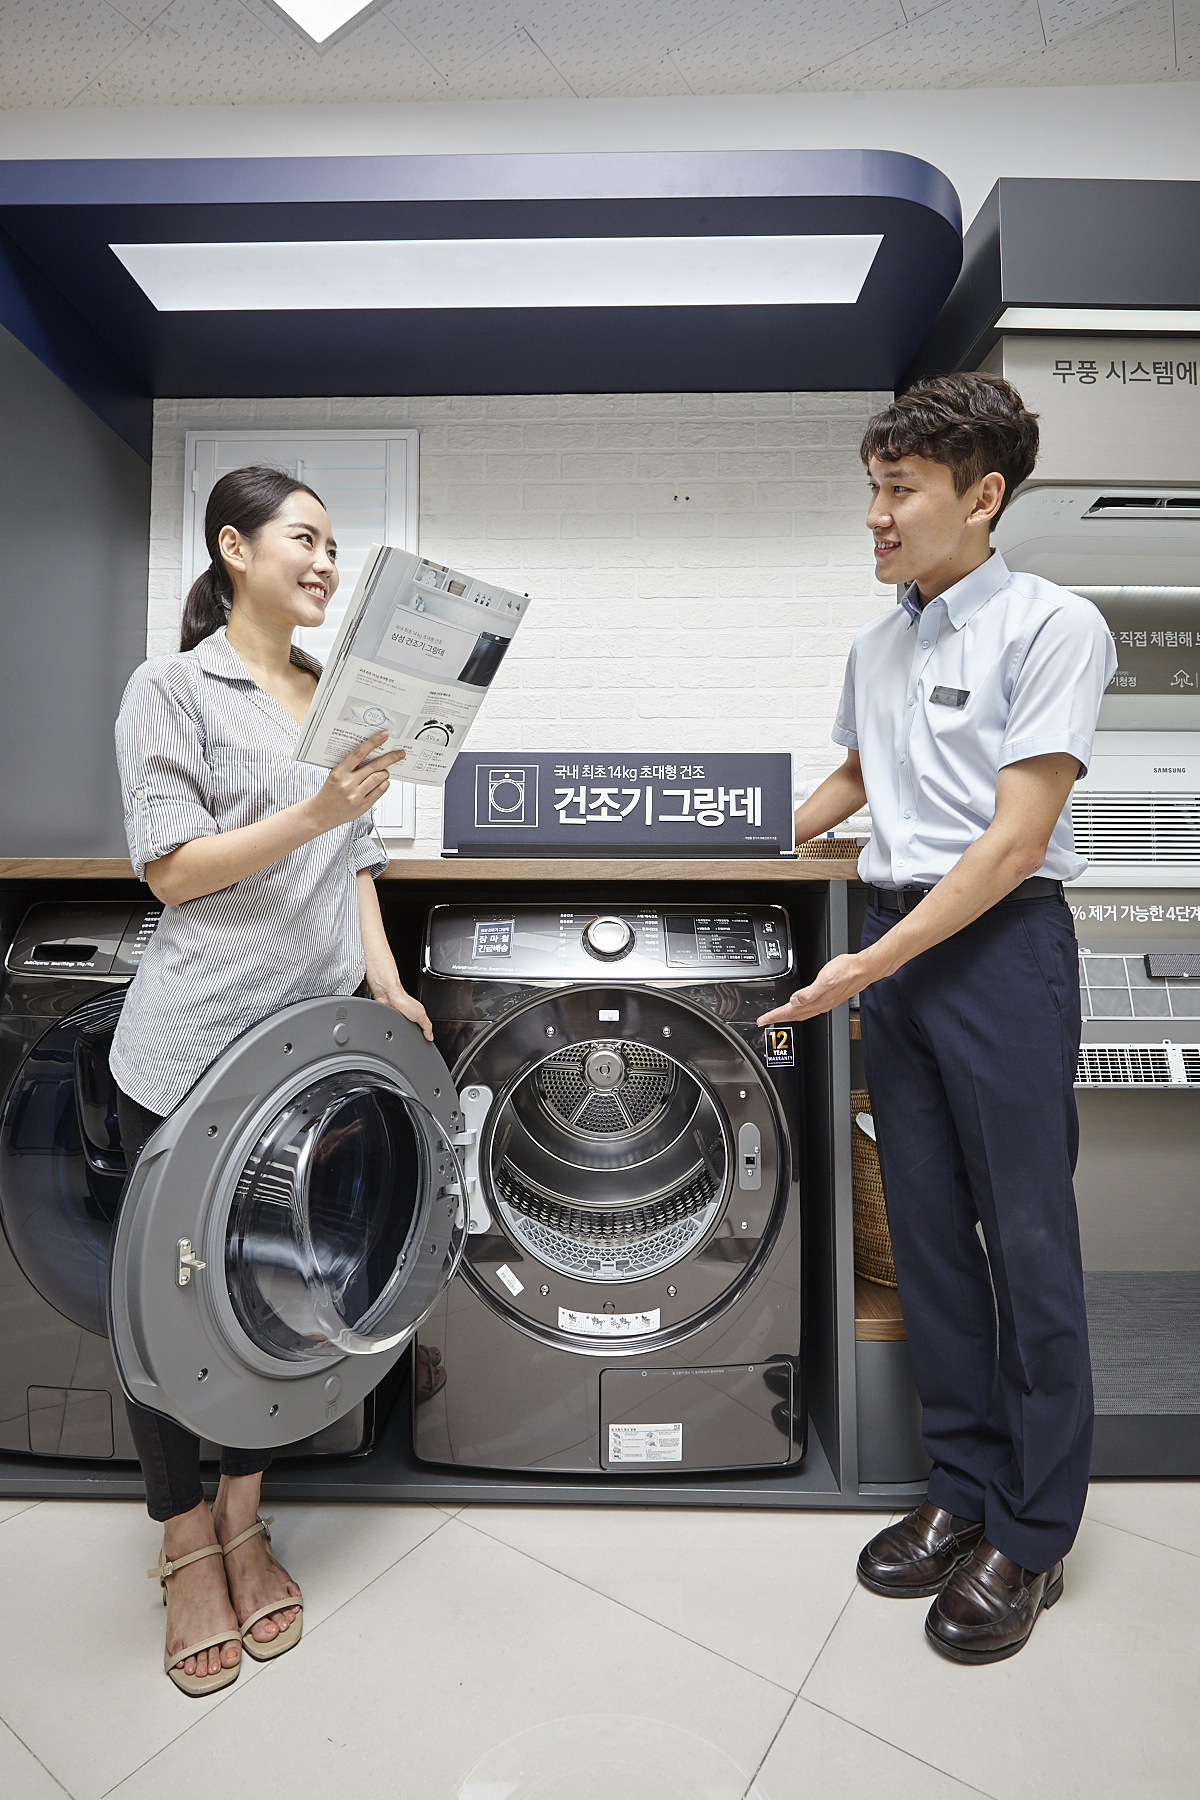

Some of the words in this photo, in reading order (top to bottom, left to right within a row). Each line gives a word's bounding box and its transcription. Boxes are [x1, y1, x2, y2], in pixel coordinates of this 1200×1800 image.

[1052, 360, 1099, 385] 무풍
[1105, 360, 1198, 386] 시스템에
[391, 632, 406, 644] 삼성
[406, 637, 425, 651] 건조기
[425, 644, 446, 657] 그랑데
[1119, 630, 1147, 648] 직접
[1150, 630, 1193, 648] 체험해
[553, 764, 580, 780] 국내
[581, 764, 607, 780] 최초
[607, 765, 638, 782] 14kg
[639, 764, 678, 780] 초대형
[679, 765, 706, 780] 건조
[553, 785, 653, 826] 건조기
[658, 786, 762, 827] 그랑데
[1088, 905, 1118, 922] 제거
[1120, 905, 1165, 922] 가능한
[478, 944, 508, 953] 긴급배송
[769, 1031, 788, 1049] 12
